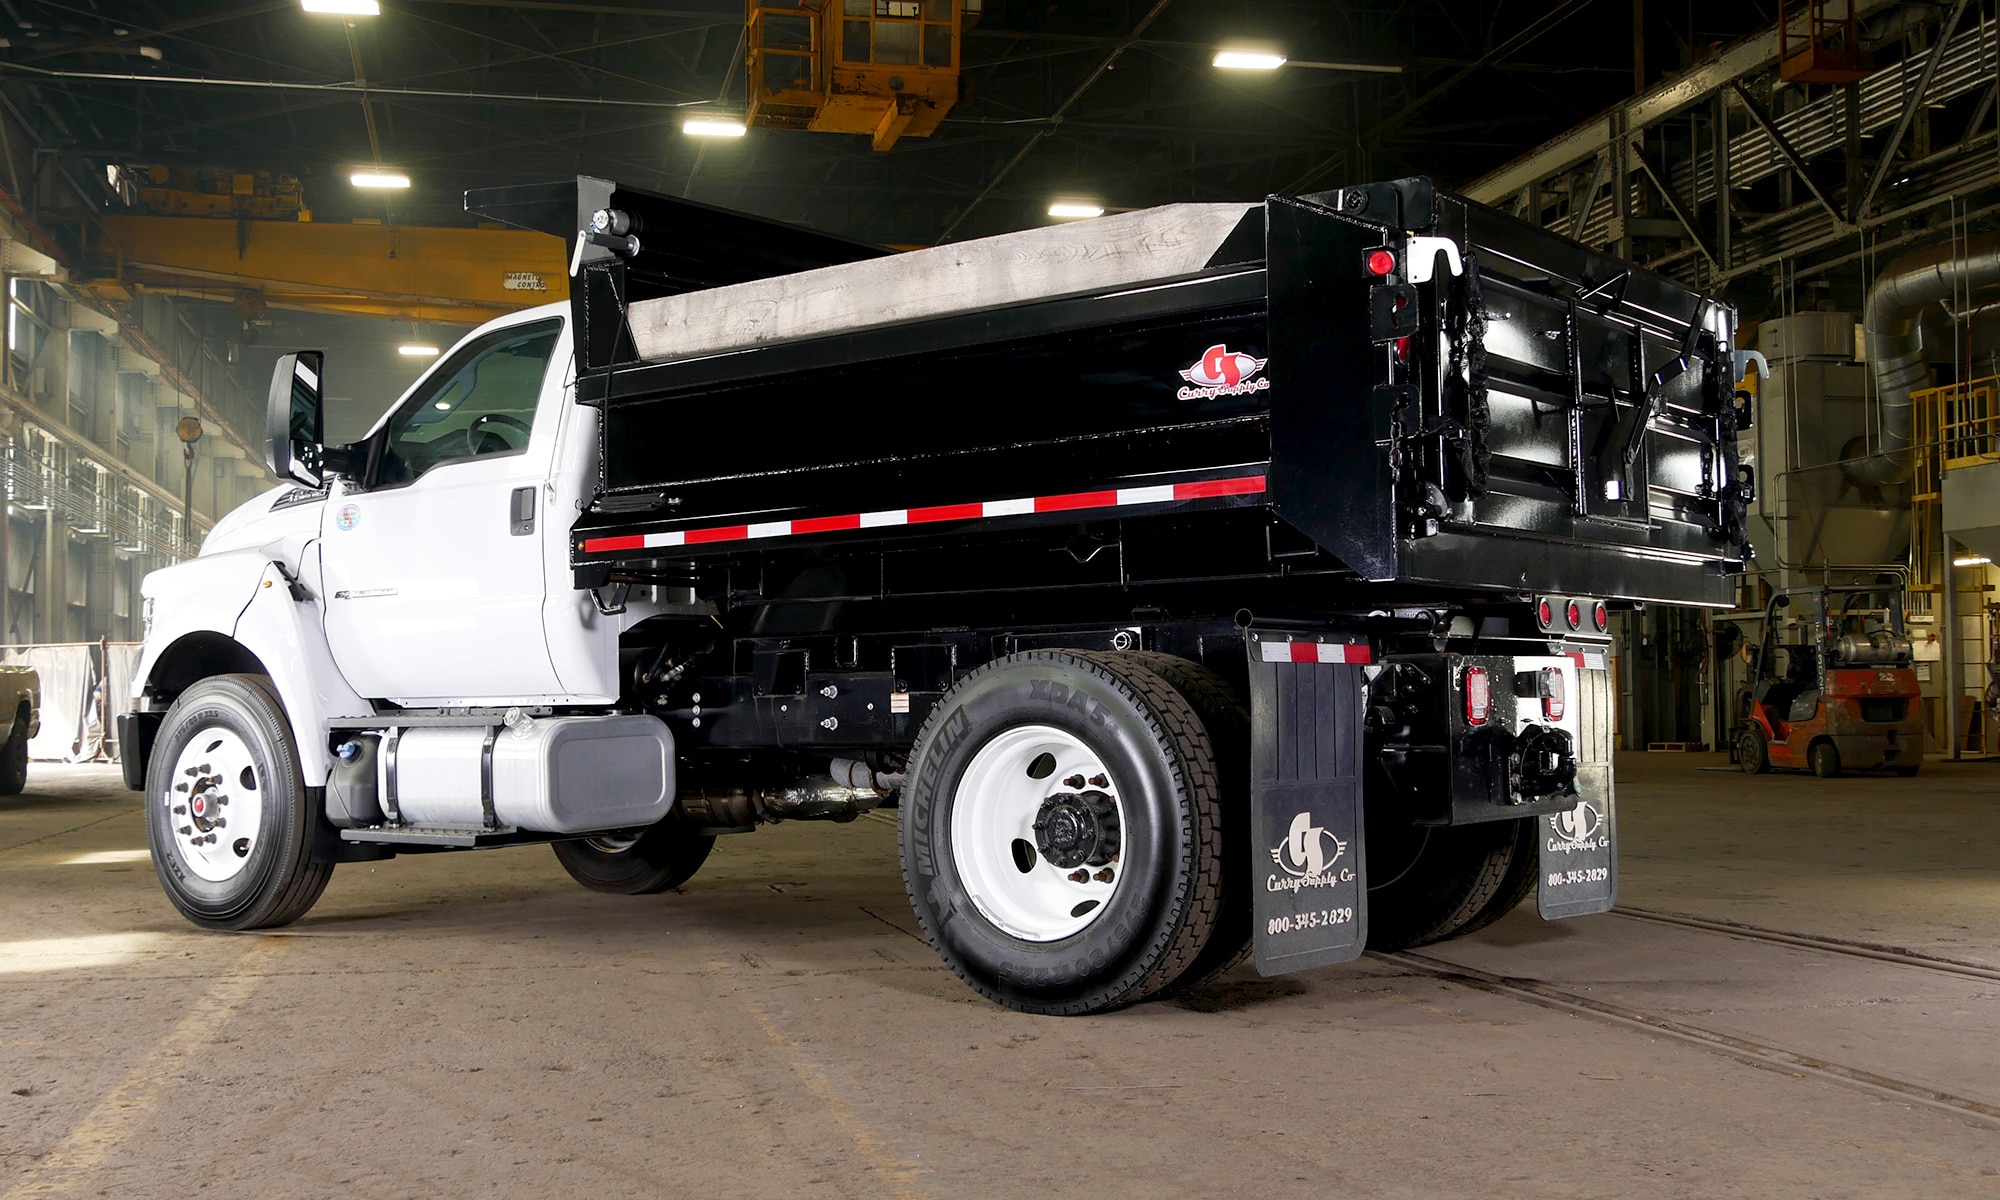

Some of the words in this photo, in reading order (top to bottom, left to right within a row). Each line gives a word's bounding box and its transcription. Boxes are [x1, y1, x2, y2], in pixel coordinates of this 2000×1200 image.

[1177, 386, 1217, 400] Curry
[1217, 383, 1256, 396] Supply
[1256, 377, 1270, 389] Co
[914, 710, 965, 876] MICHELIN
[1547, 838, 1570, 854] Curry
[1267, 874, 1300, 893] Curry
[1300, 871, 1338, 888] Supply
[1340, 868, 1356, 882] Co
[1548, 868, 1608, 887] 800-345-2829
[1267, 907, 1352, 935] 800-345-2829
